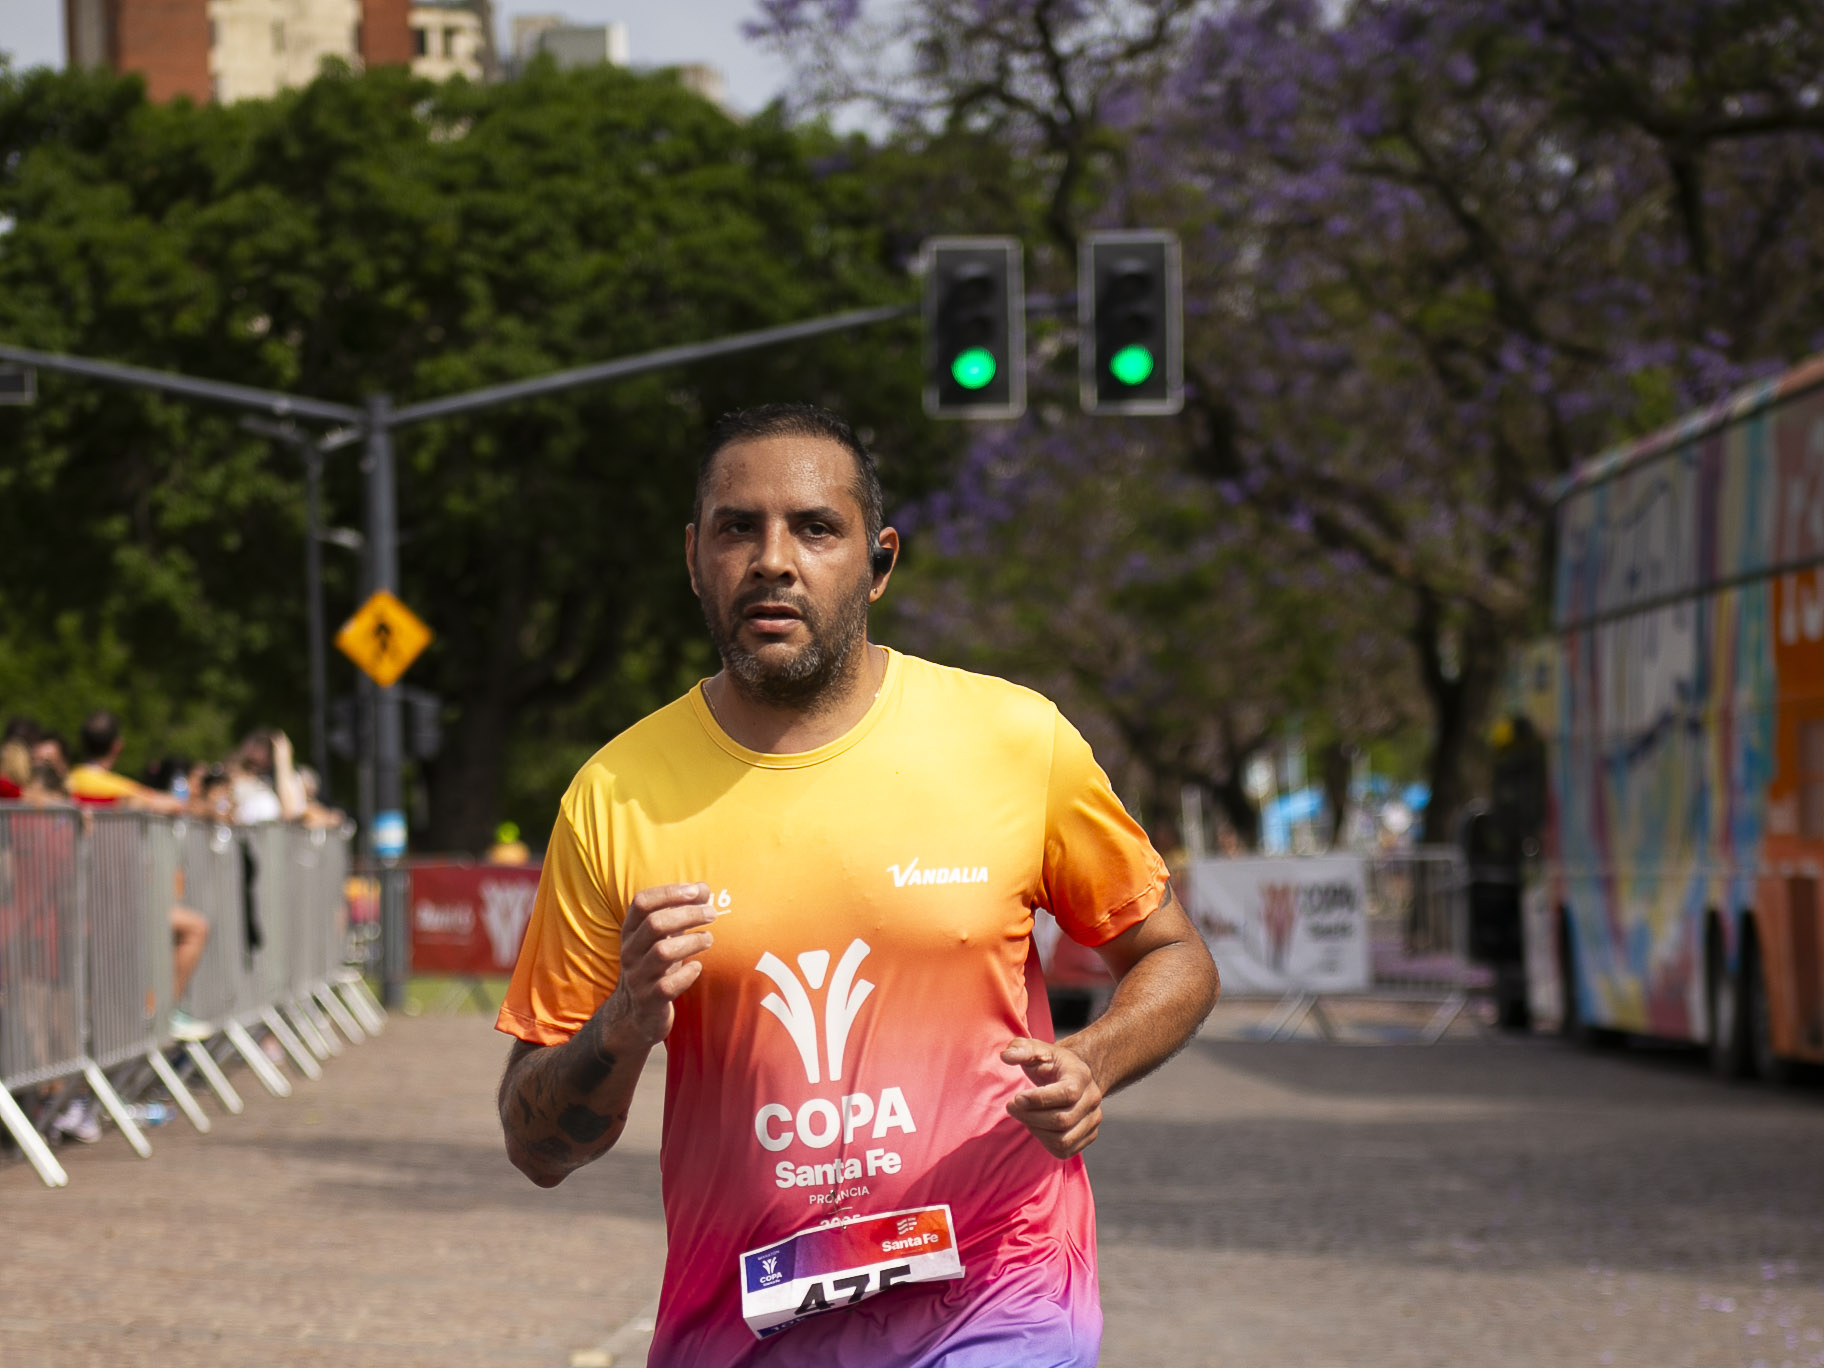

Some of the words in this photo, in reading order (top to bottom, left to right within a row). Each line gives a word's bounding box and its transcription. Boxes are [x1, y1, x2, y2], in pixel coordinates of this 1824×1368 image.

[886, 857, 988, 888] VANDALIA
[754, 1086, 917, 1152] COPA
[775, 1158, 863, 1189] Santa
[865, 1148, 902, 1177] Fe
[809, 1186, 870, 1205] PRONCIA
[881, 1236, 923, 1252] Santa
[922, 1232, 939, 1244] Fe
[759, 1271, 783, 1284] COPA
